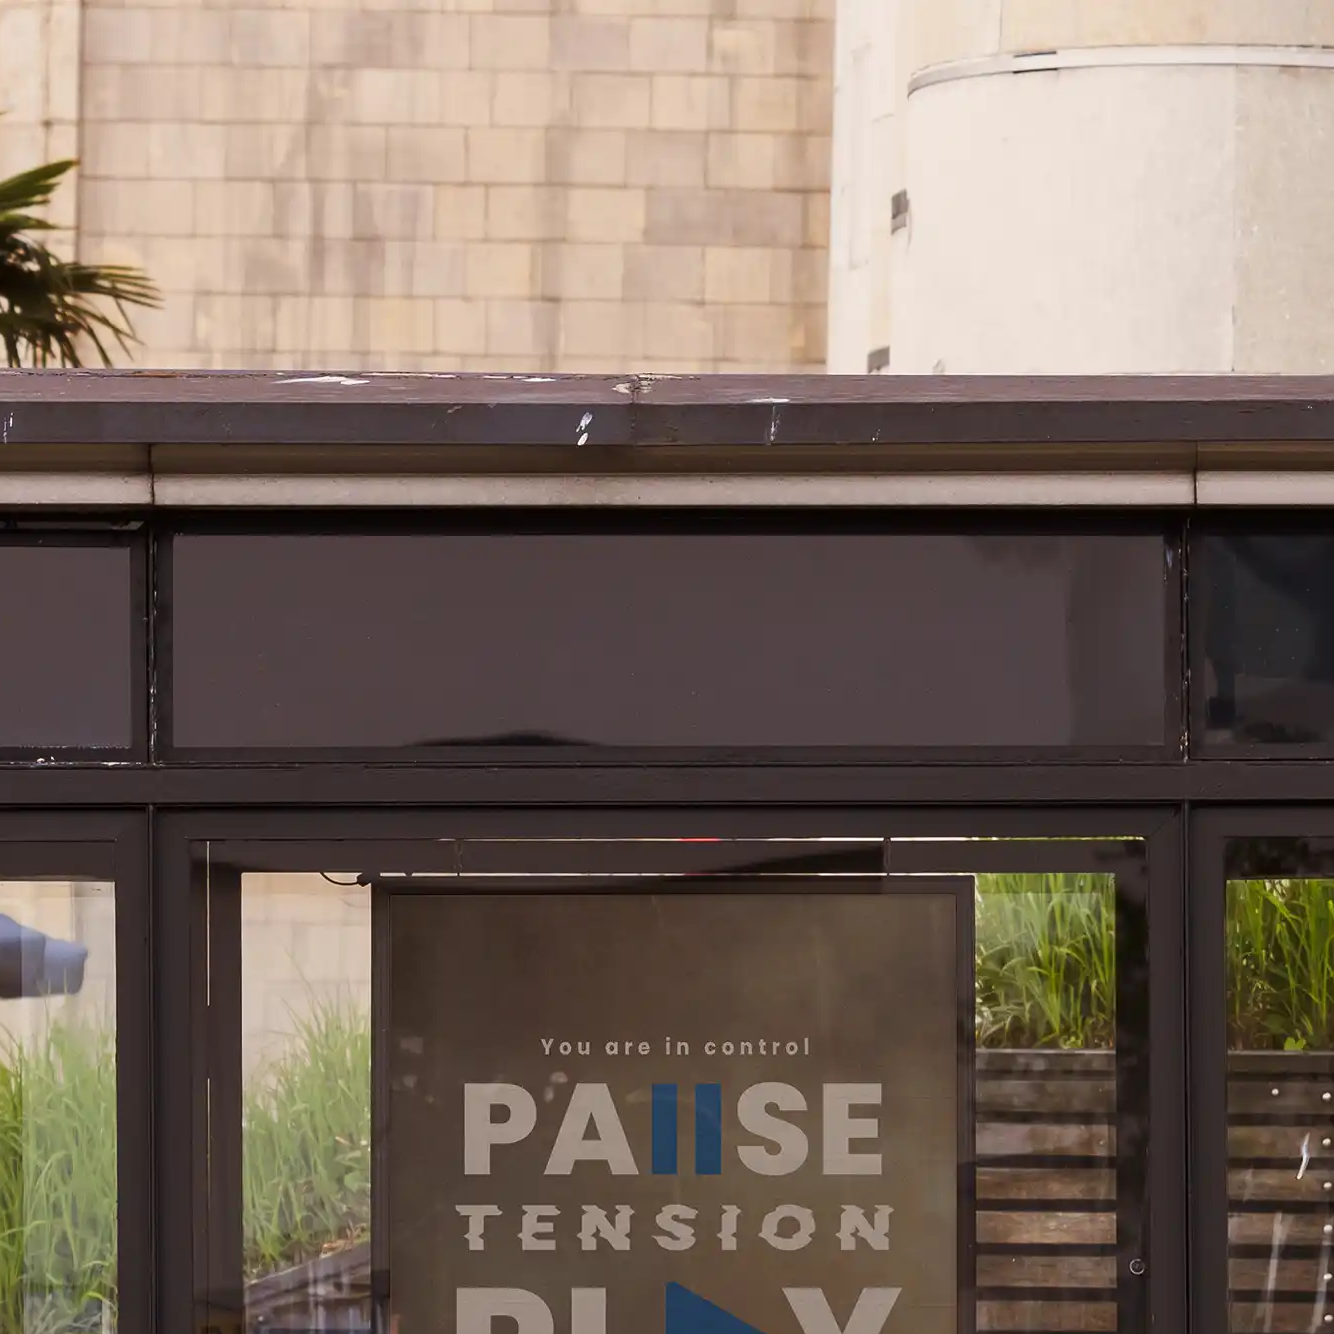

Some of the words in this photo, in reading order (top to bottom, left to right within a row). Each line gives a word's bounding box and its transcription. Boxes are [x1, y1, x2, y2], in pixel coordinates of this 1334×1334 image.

[540, 1037, 591, 1056] You
[604, 1041, 652, 1056] are
[665, 1036, 691, 1056] in
[703, 1037, 810, 1056] control
[455, 1203, 895, 1251] TENSION
